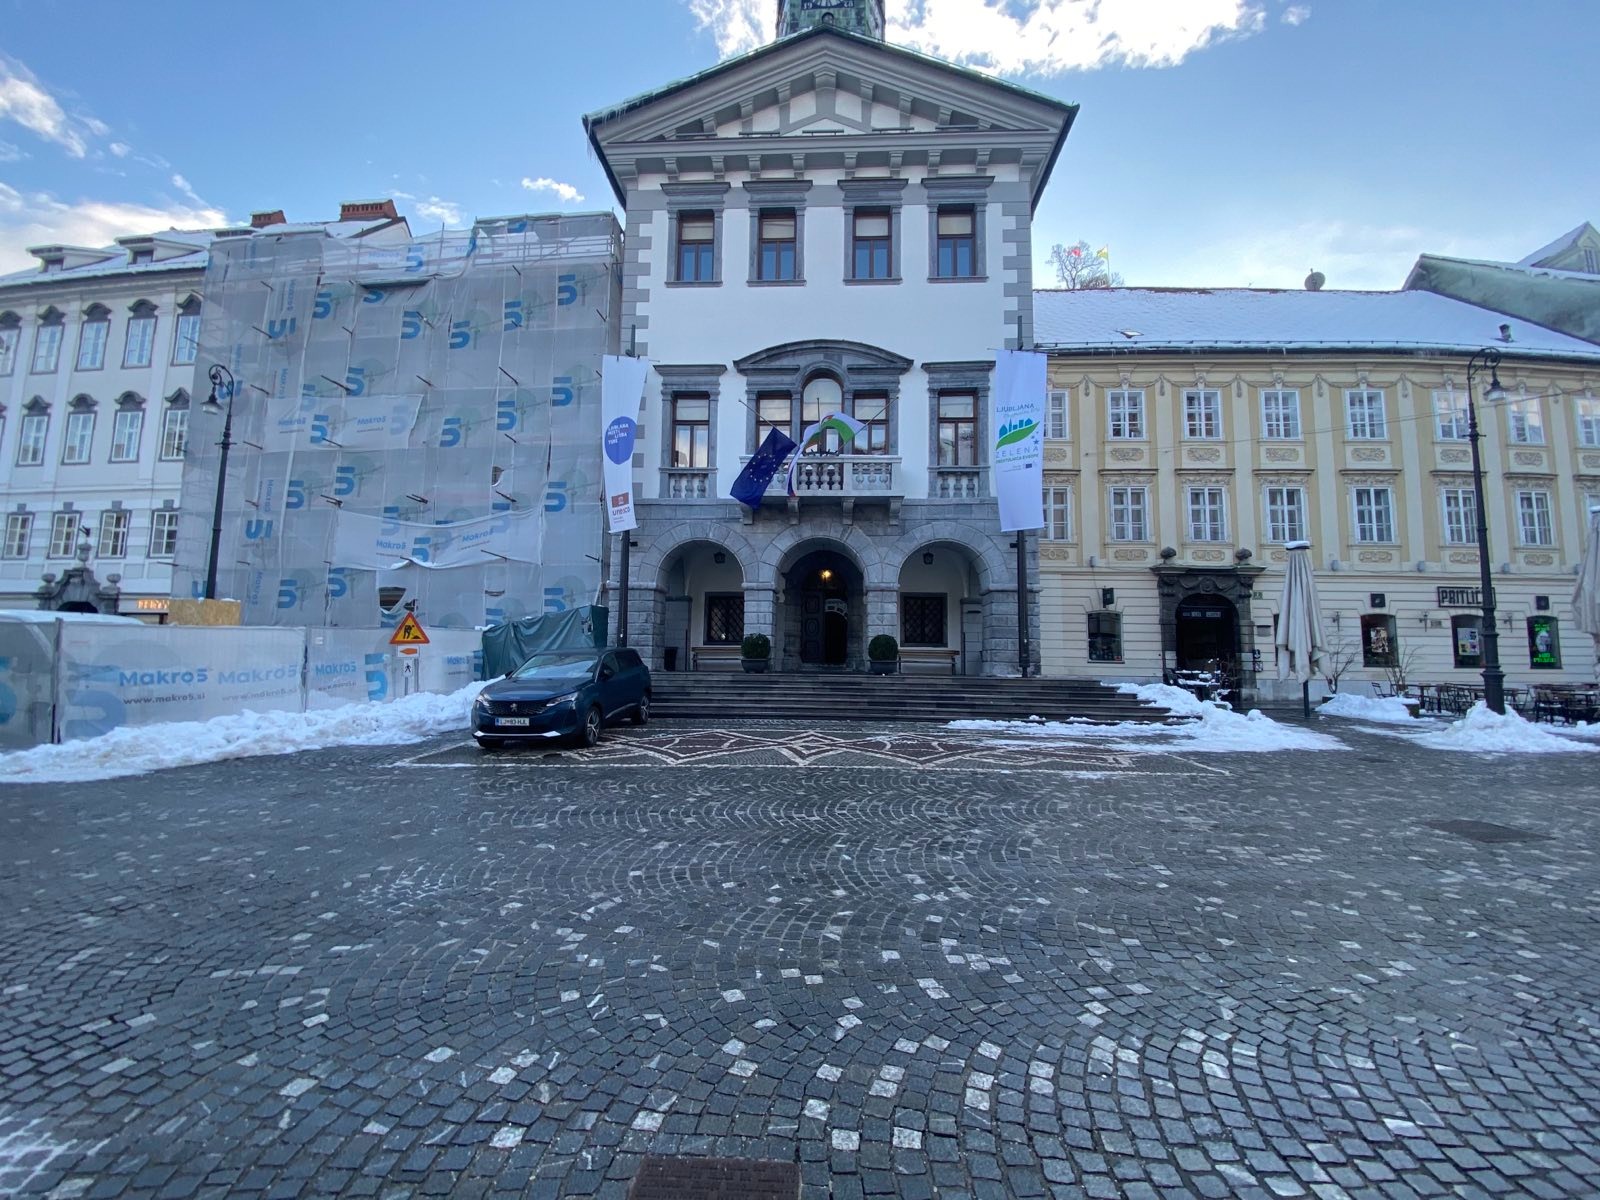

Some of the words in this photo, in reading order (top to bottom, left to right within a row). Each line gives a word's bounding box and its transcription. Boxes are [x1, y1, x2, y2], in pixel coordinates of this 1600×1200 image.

[1441, 586, 1482, 604] PRITLIČ
[119, 668, 208, 687] Makro5
[218, 664, 297, 685] Makro5
